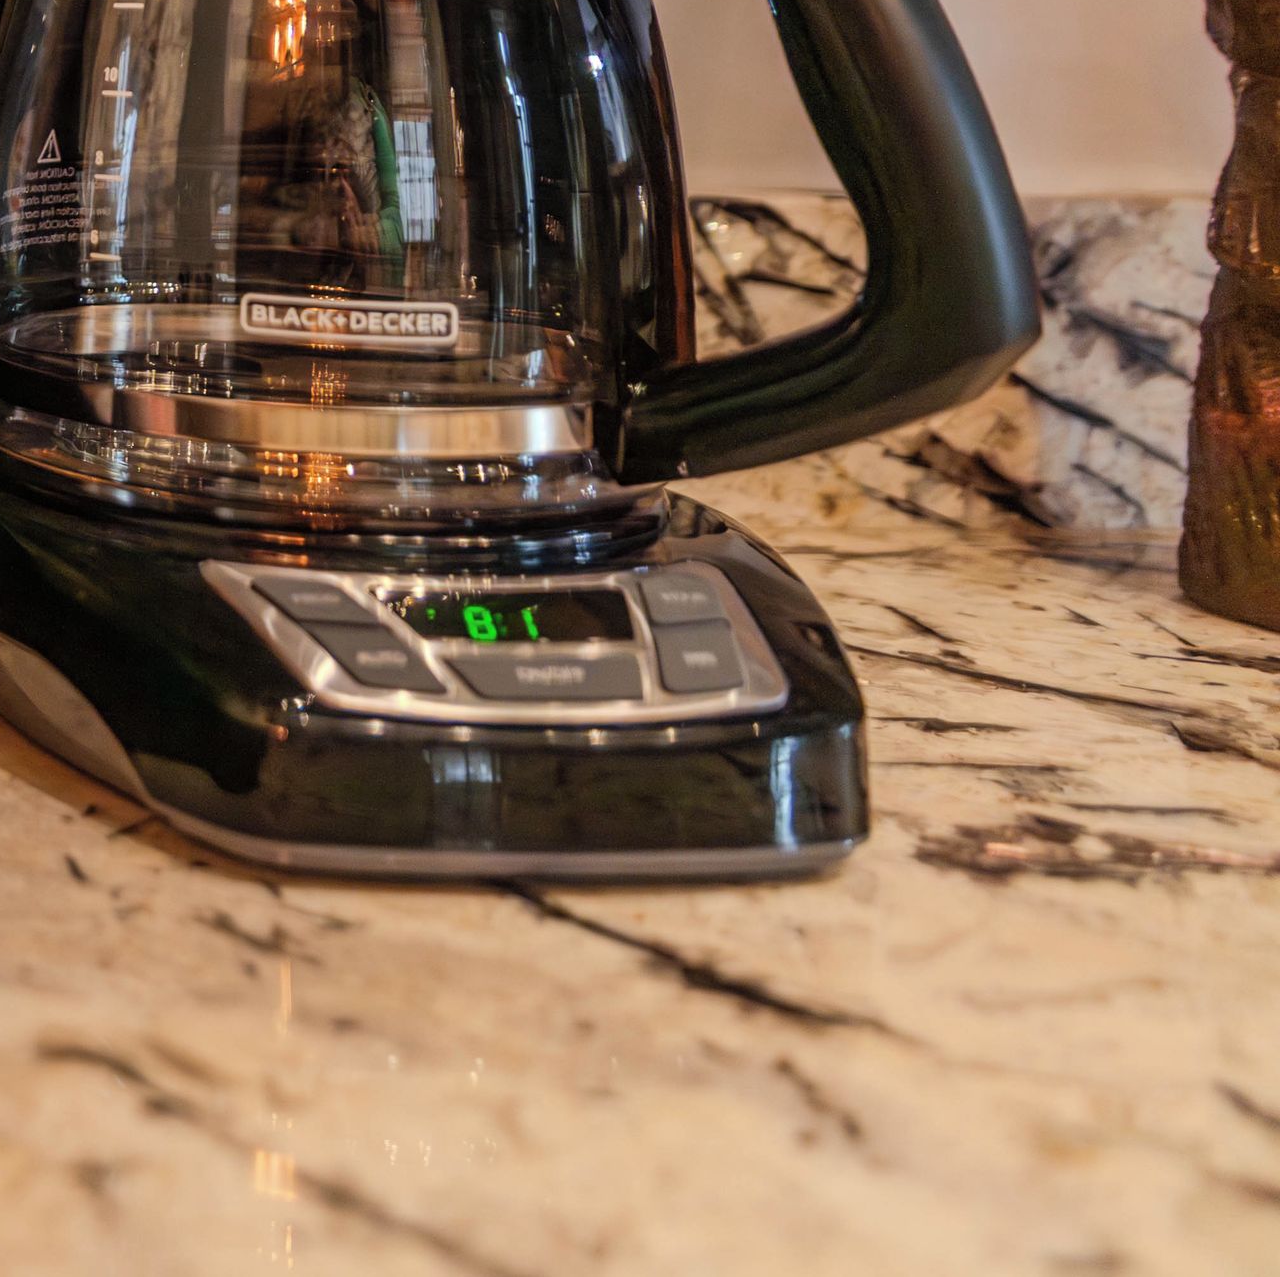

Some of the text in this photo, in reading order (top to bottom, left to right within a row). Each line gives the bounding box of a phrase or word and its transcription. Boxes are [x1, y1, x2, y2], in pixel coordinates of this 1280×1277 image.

[103, 66, 118, 82] 10
[95, 150, 104, 165] 8
[251, 303, 449, 335] BLACK+DECKER
